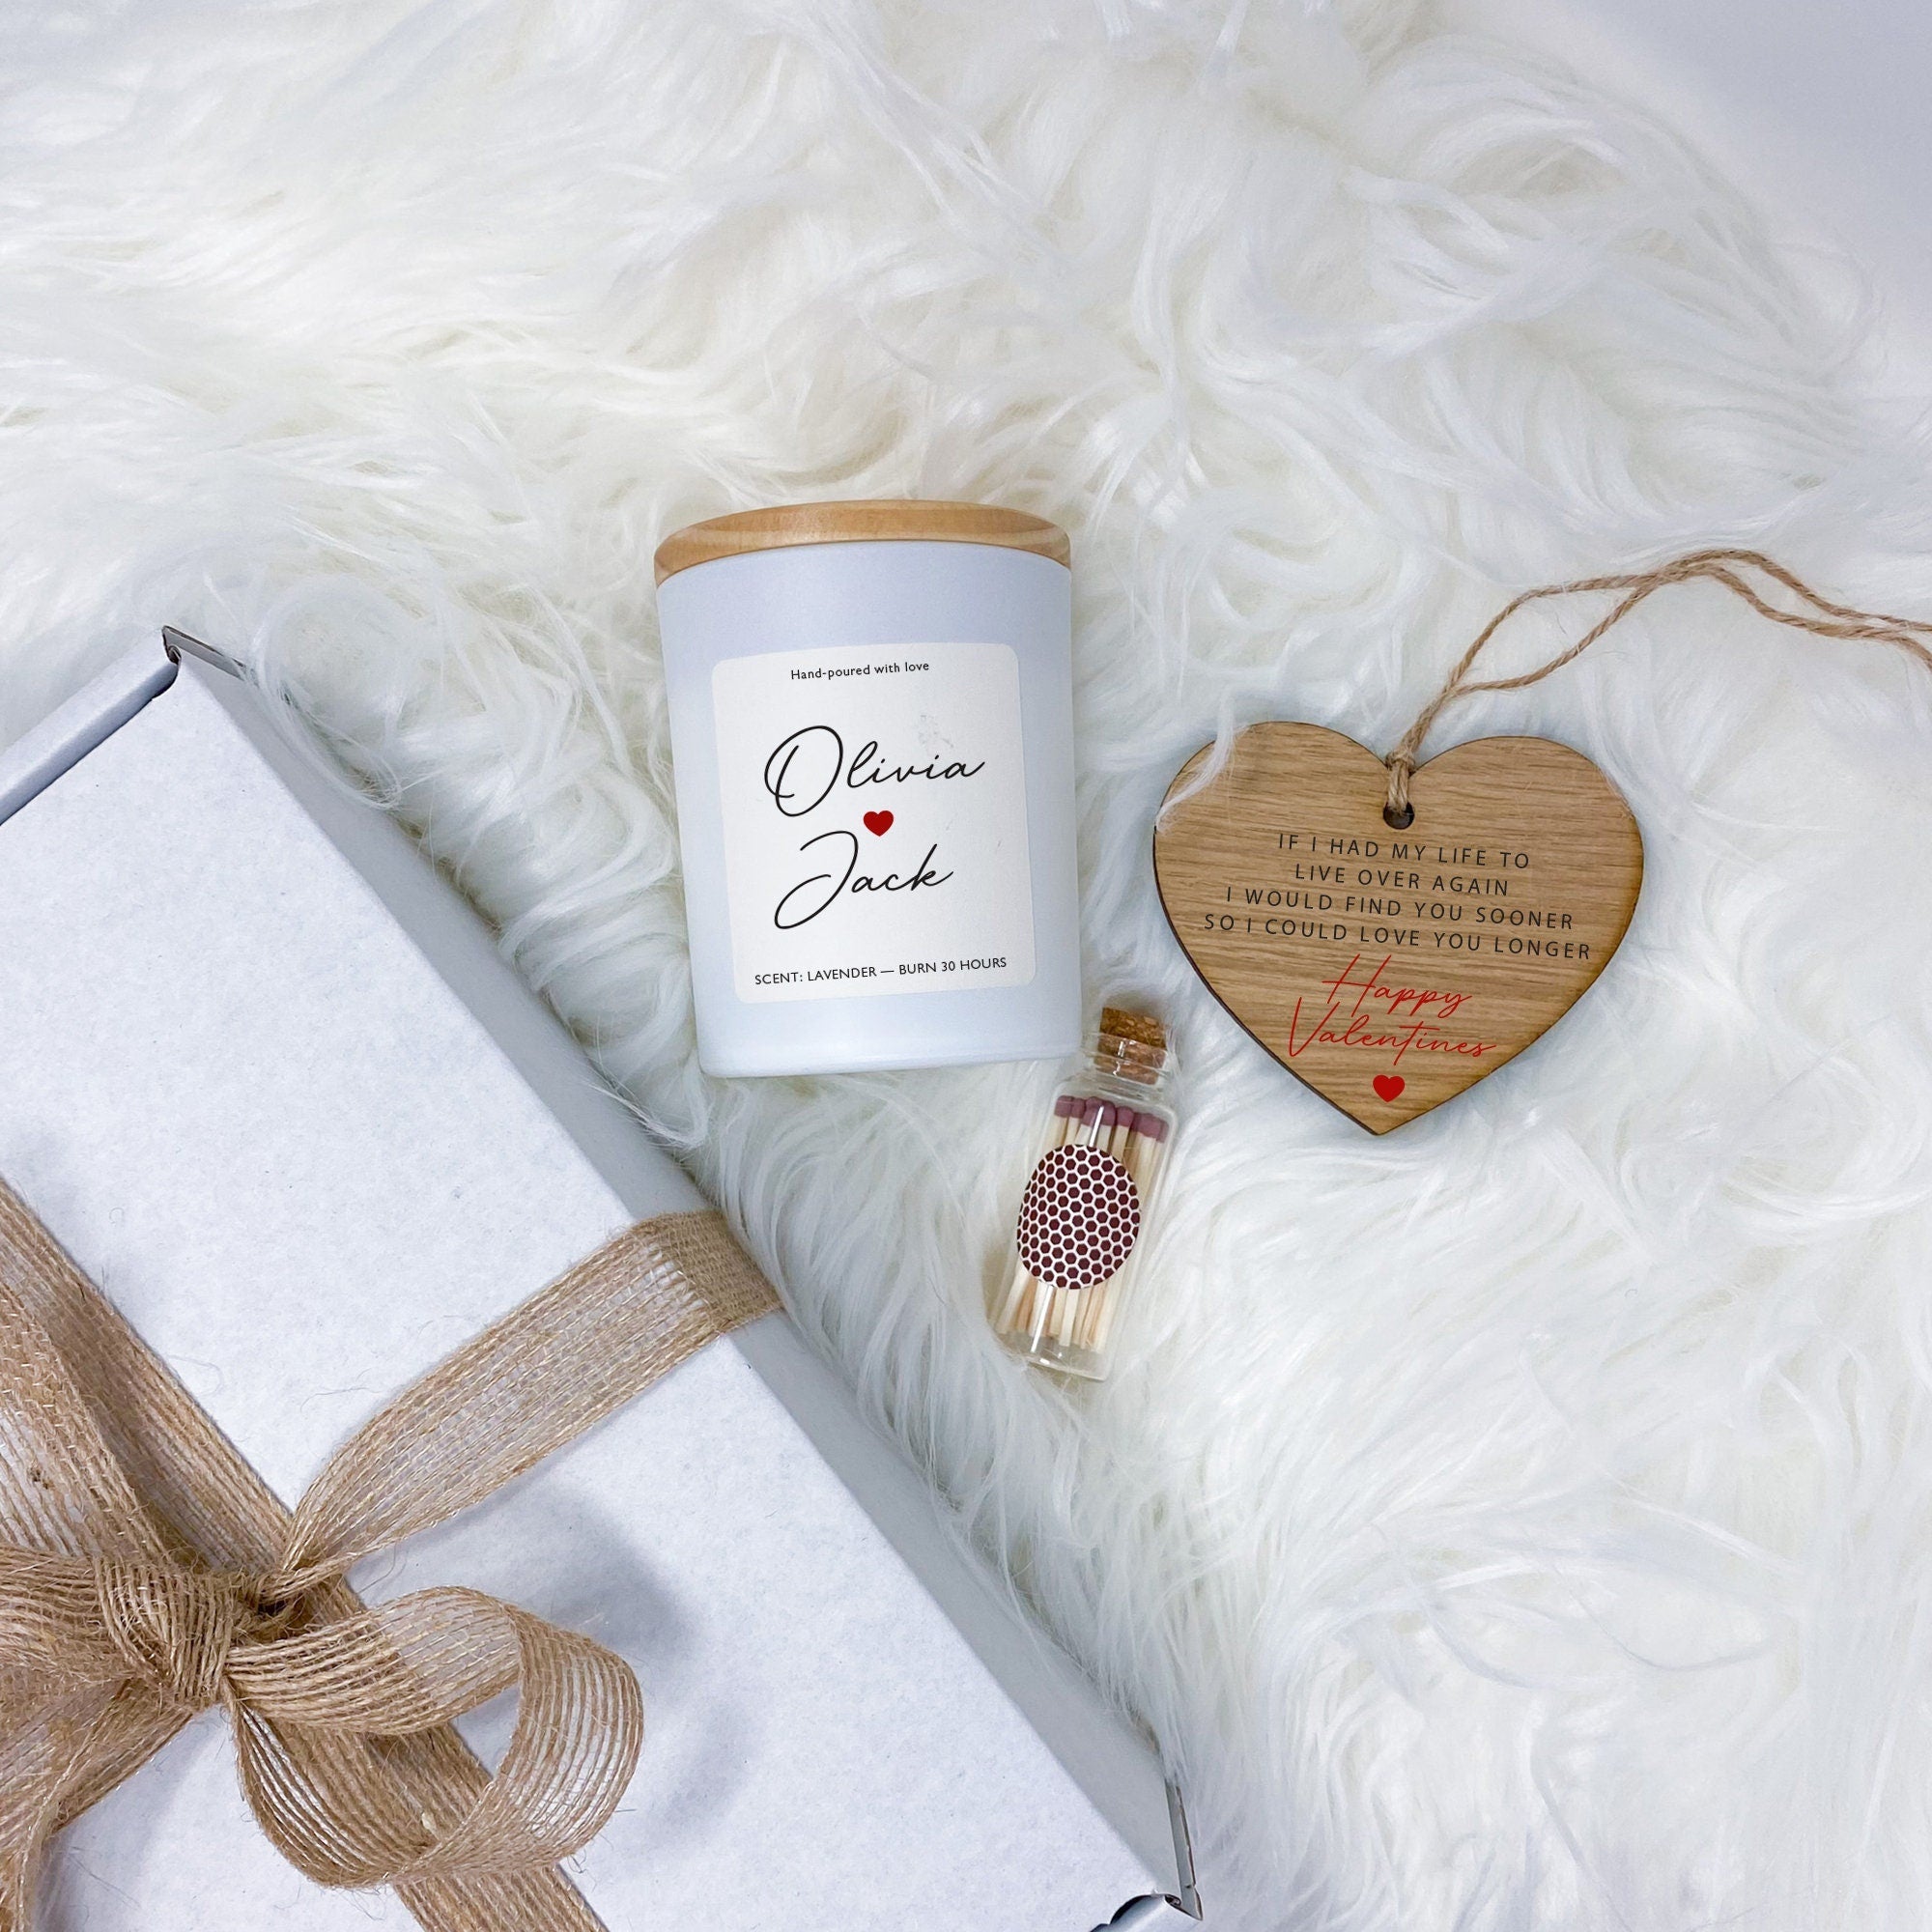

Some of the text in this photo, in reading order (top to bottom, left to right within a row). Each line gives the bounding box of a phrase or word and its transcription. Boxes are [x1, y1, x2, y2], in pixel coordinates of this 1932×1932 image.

[790, 661, 929, 681] Hand-poured with love
[763, 724, 985, 817] Olivia
[1279, 833, 1529, 869] IF I HAD MY LIFE TO
[774, 830, 954, 930] Jack
[1295, 863, 1508, 897] LIVE OVER AGAIN
[1226, 886, 1573, 930] I WOULD FIND YOU SOONER
[1204, 913, 1590, 960] SO I COULD LOVE YOU LONGER
[754, 971, 803, 985] SCENT:
[807, 966, 877, 981] LAVENDER
[898, 961, 937, 976] BURN
[941, 960, 956, 972] 30
[959, 956, 1008, 971] HOURS
[1321, 952, 1473, 1018] Happy
[1288, 996, 1497, 1066] Valentines
